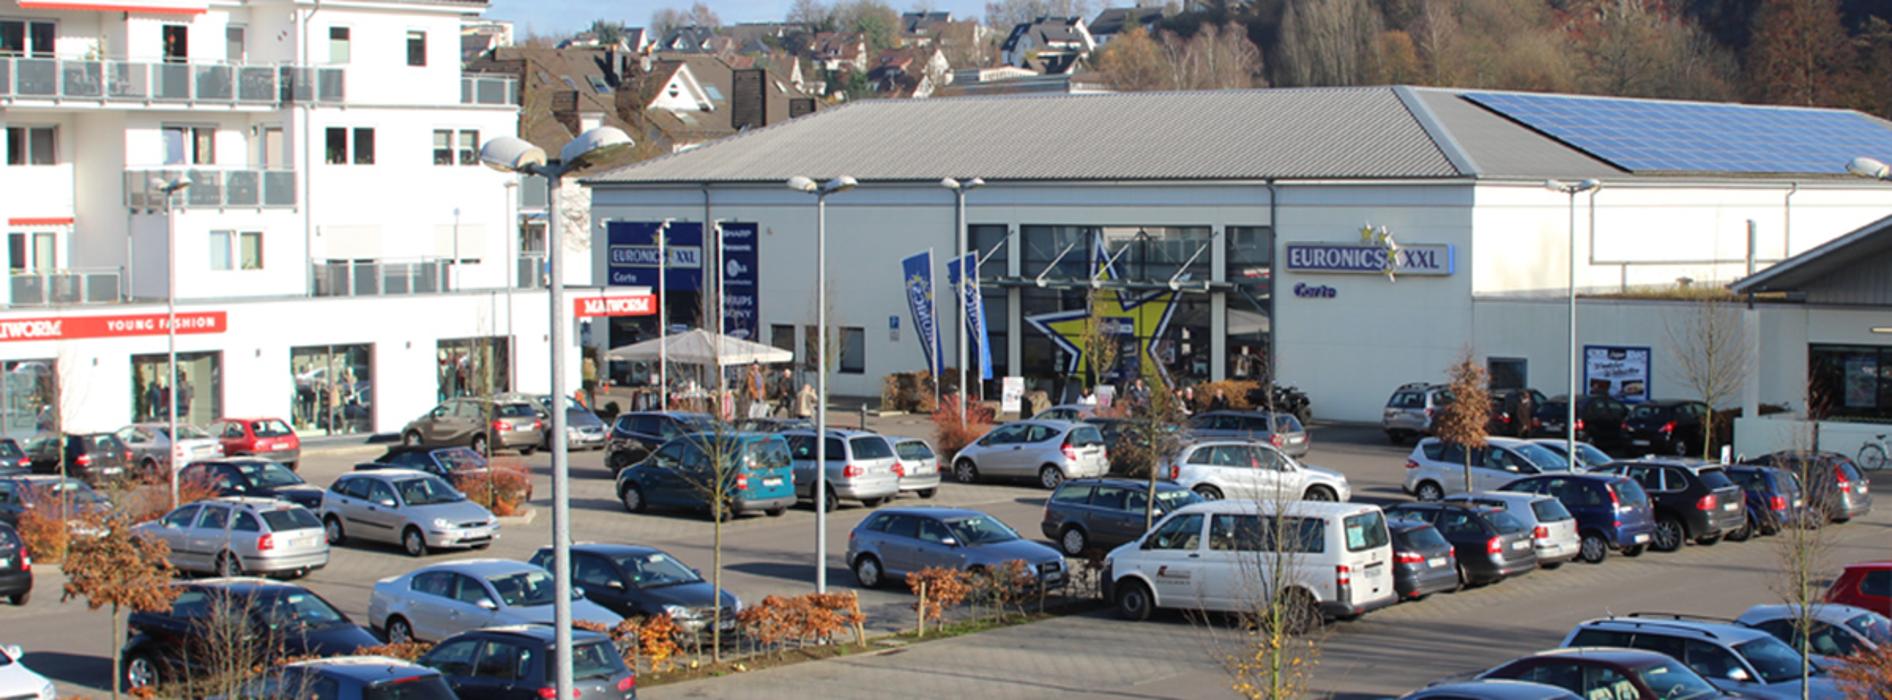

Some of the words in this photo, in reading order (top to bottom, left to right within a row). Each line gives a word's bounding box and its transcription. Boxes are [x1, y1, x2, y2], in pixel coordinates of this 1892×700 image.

[612, 248, 665, 263] EURONIC
[676, 249, 696, 264] XXL
[1290, 247, 1386, 269] EURONICS
[1404, 249, 1440, 269] XXL
[107, 319, 154, 331] YOUNG
